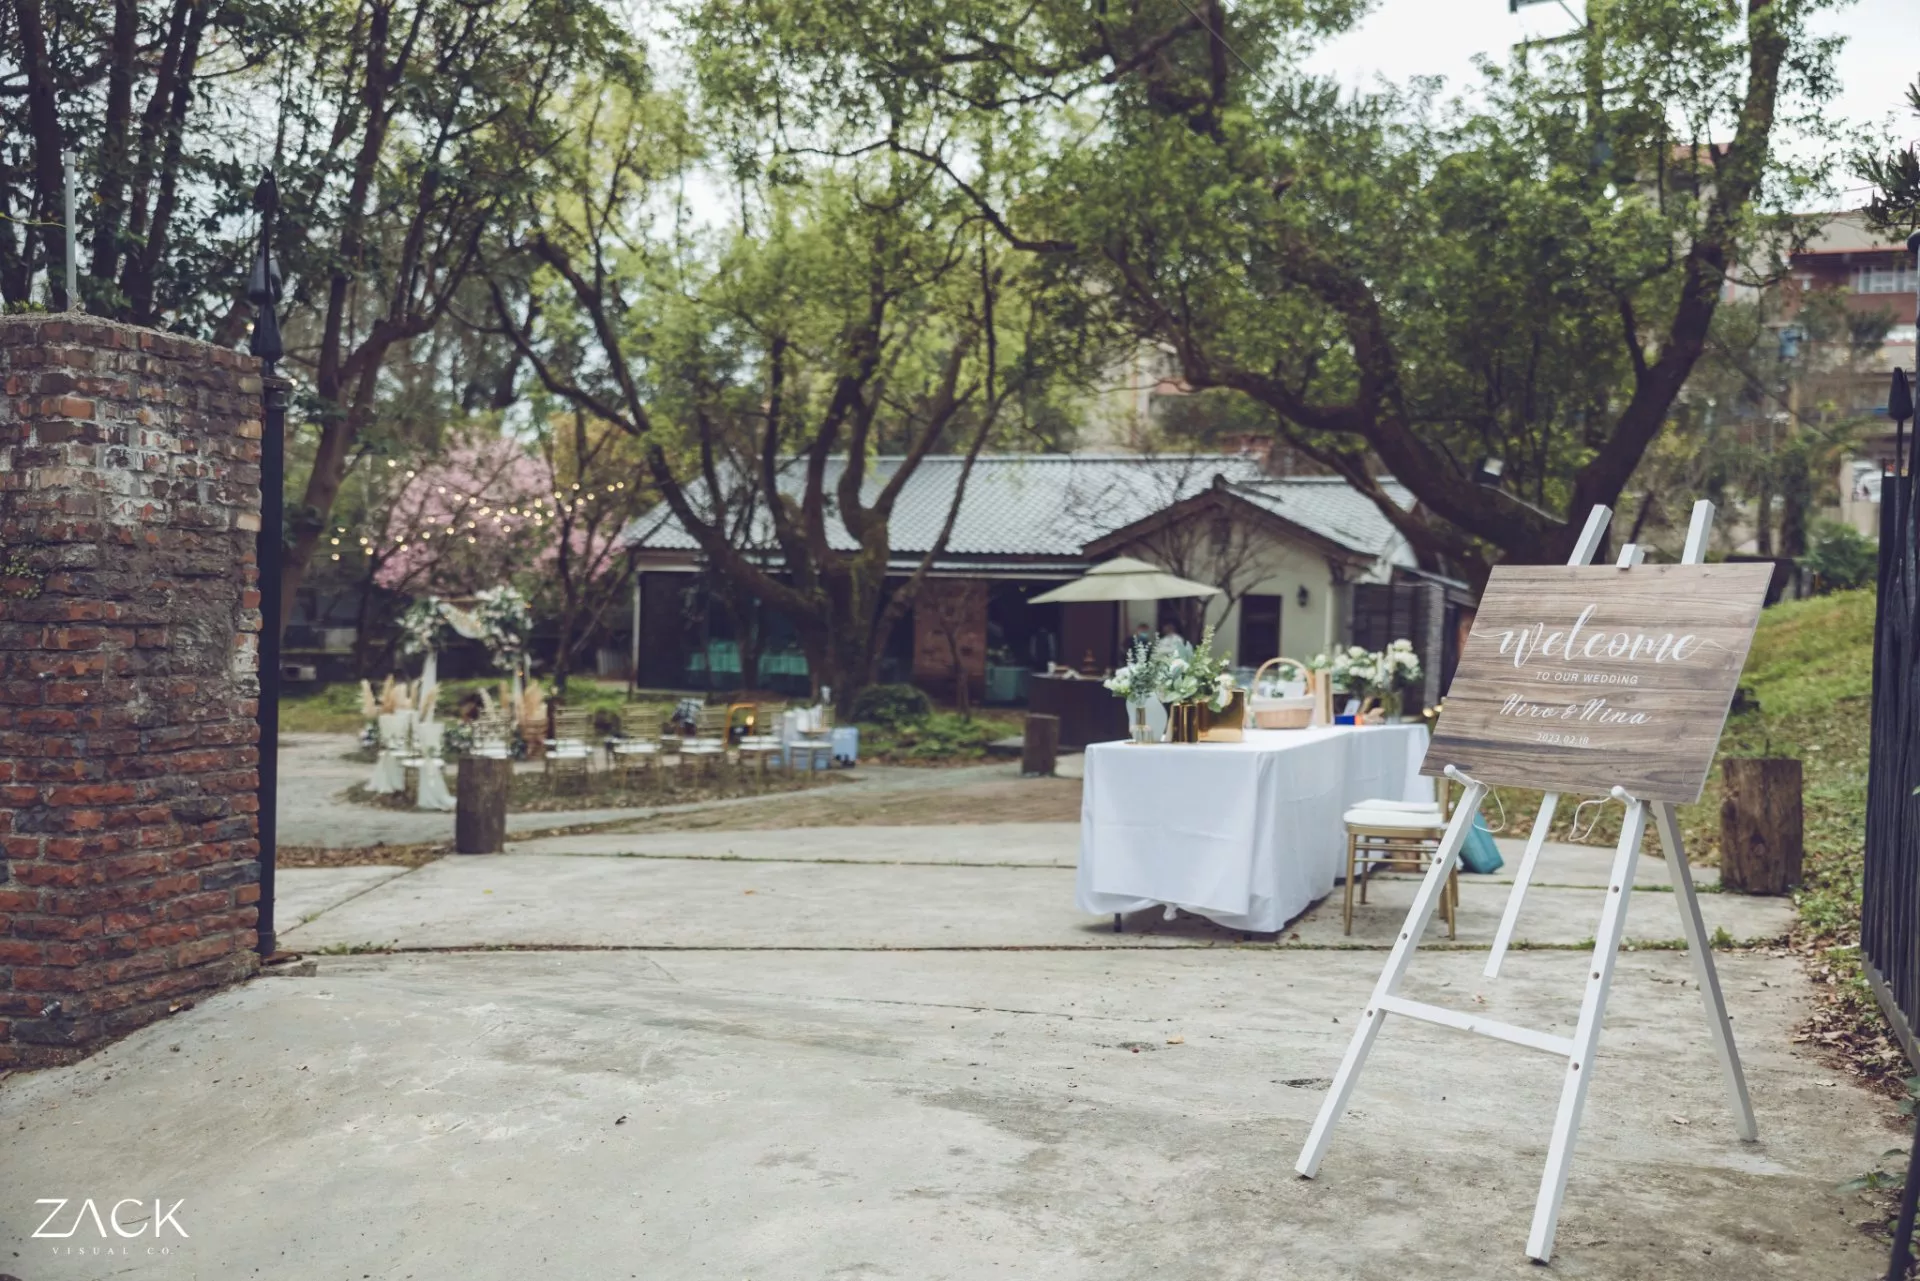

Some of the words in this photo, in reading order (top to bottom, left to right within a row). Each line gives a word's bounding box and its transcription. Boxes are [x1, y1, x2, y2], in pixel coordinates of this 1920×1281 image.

[1470, 603, 1746, 668] welcome
[1535, 671, 1550, 681] TO
[1554, 672, 1579, 683] OUR
[1583, 674, 1639, 685] WEDDING
[1499, 693, 1559, 719] Hiro
[1560, 704, 1578, 720] &
[1579, 698, 1652, 725] Nina
